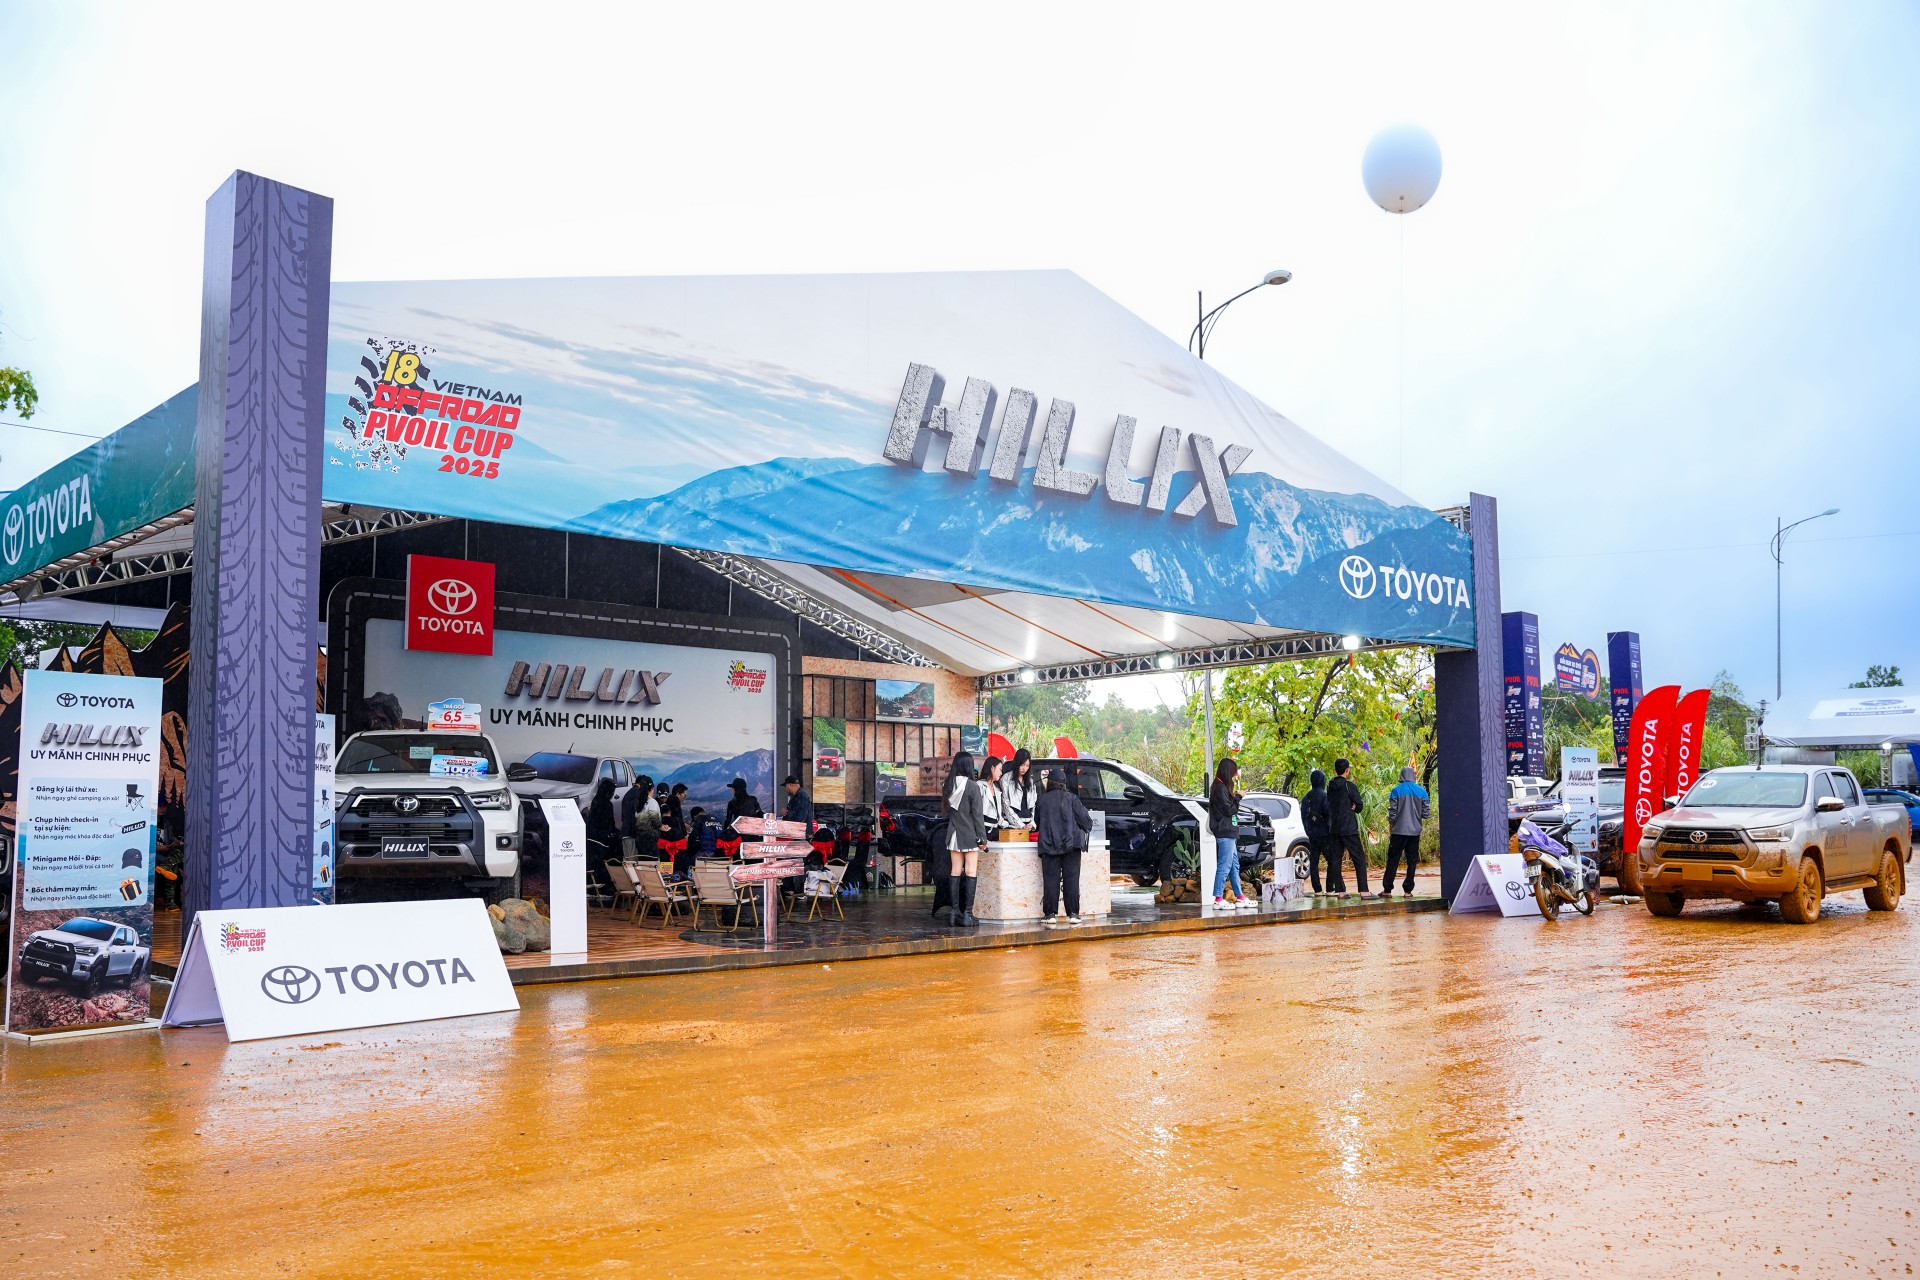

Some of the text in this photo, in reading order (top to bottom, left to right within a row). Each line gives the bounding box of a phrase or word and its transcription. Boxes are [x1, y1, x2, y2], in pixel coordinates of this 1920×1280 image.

[383, 350, 420, 385] 18
[433, 379, 522, 406] VIETNAM
[373, 384, 521, 430] OFFROAD
[362, 409, 514, 459] PVOIL CUP
[882, 361, 1253, 527] HILUX
[438, 454, 500, 479] 2025
[27, 474, 92, 549] TOYOTA
[1379, 565, 1471, 609] TOYOTA
[418, 616, 484, 635] TOYOTA
[504, 660, 672, 705] HILUX
[80, 695, 135, 709] TOYOTA
[444, 711, 462, 723] 6,5
[490, 707, 674, 736] UY MÃNH CHINH PHỤC
[41, 722, 151, 747] HILUX
[31, 749, 151, 764] UY MÃNH CHINH PHỤC
[1639, 719, 1659, 795] TOYOTA
[1677, 722, 1693, 797] TOYOTA
[36, 786, 54, 794] Đăng
[75, 785, 87, 793] thử
[122, 821, 145, 833] HILUX
[33, 855, 67, 863] Minigame
[85, 854, 101, 862] Đáp:
[384, 843, 427, 852] HILUX
[759, 845, 787, 853] HILUX
[324, 957, 476, 995] TOYOTA
